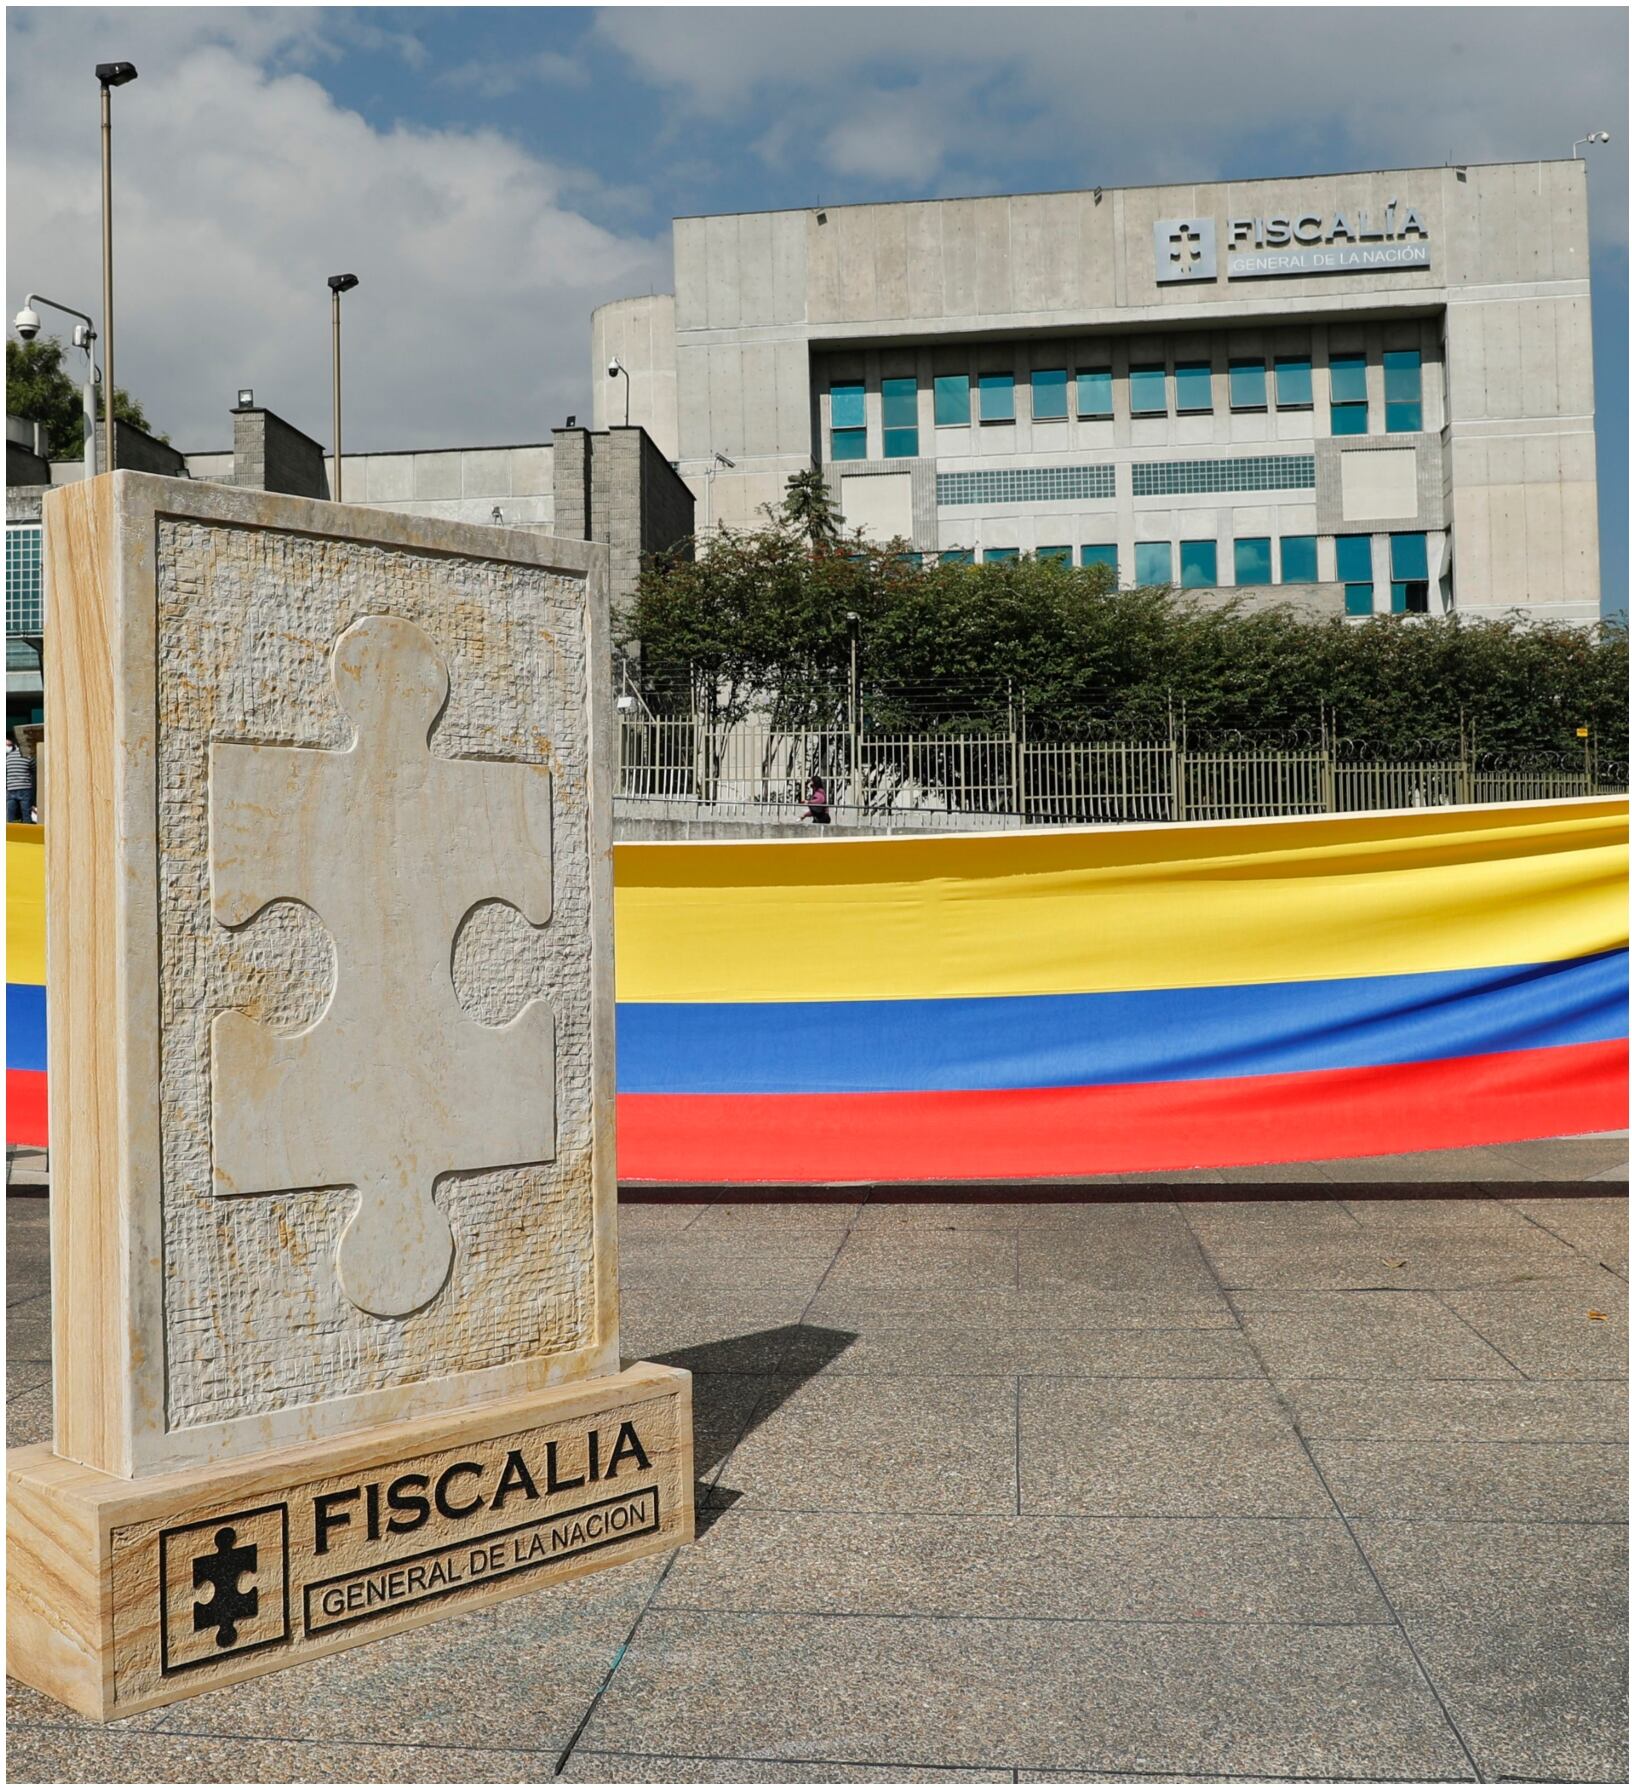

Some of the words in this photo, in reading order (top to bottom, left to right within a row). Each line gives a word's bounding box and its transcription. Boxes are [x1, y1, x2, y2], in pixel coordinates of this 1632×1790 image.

[1227, 197, 1428, 250] FISCALÍA
[1233, 255, 1306, 272] GENERAL
[1313, 252, 1336, 266] DE
[1340, 251, 1360, 265] LA
[1363, 246, 1426, 264] NACIÓN
[312, 1420, 652, 1556] FISCALIA
[322, 1558, 462, 1617] GENERAL
[470, 1544, 506, 1575] DE
[514, 1533, 546, 1563] LA
[552, 1501, 647, 1551] NACION
